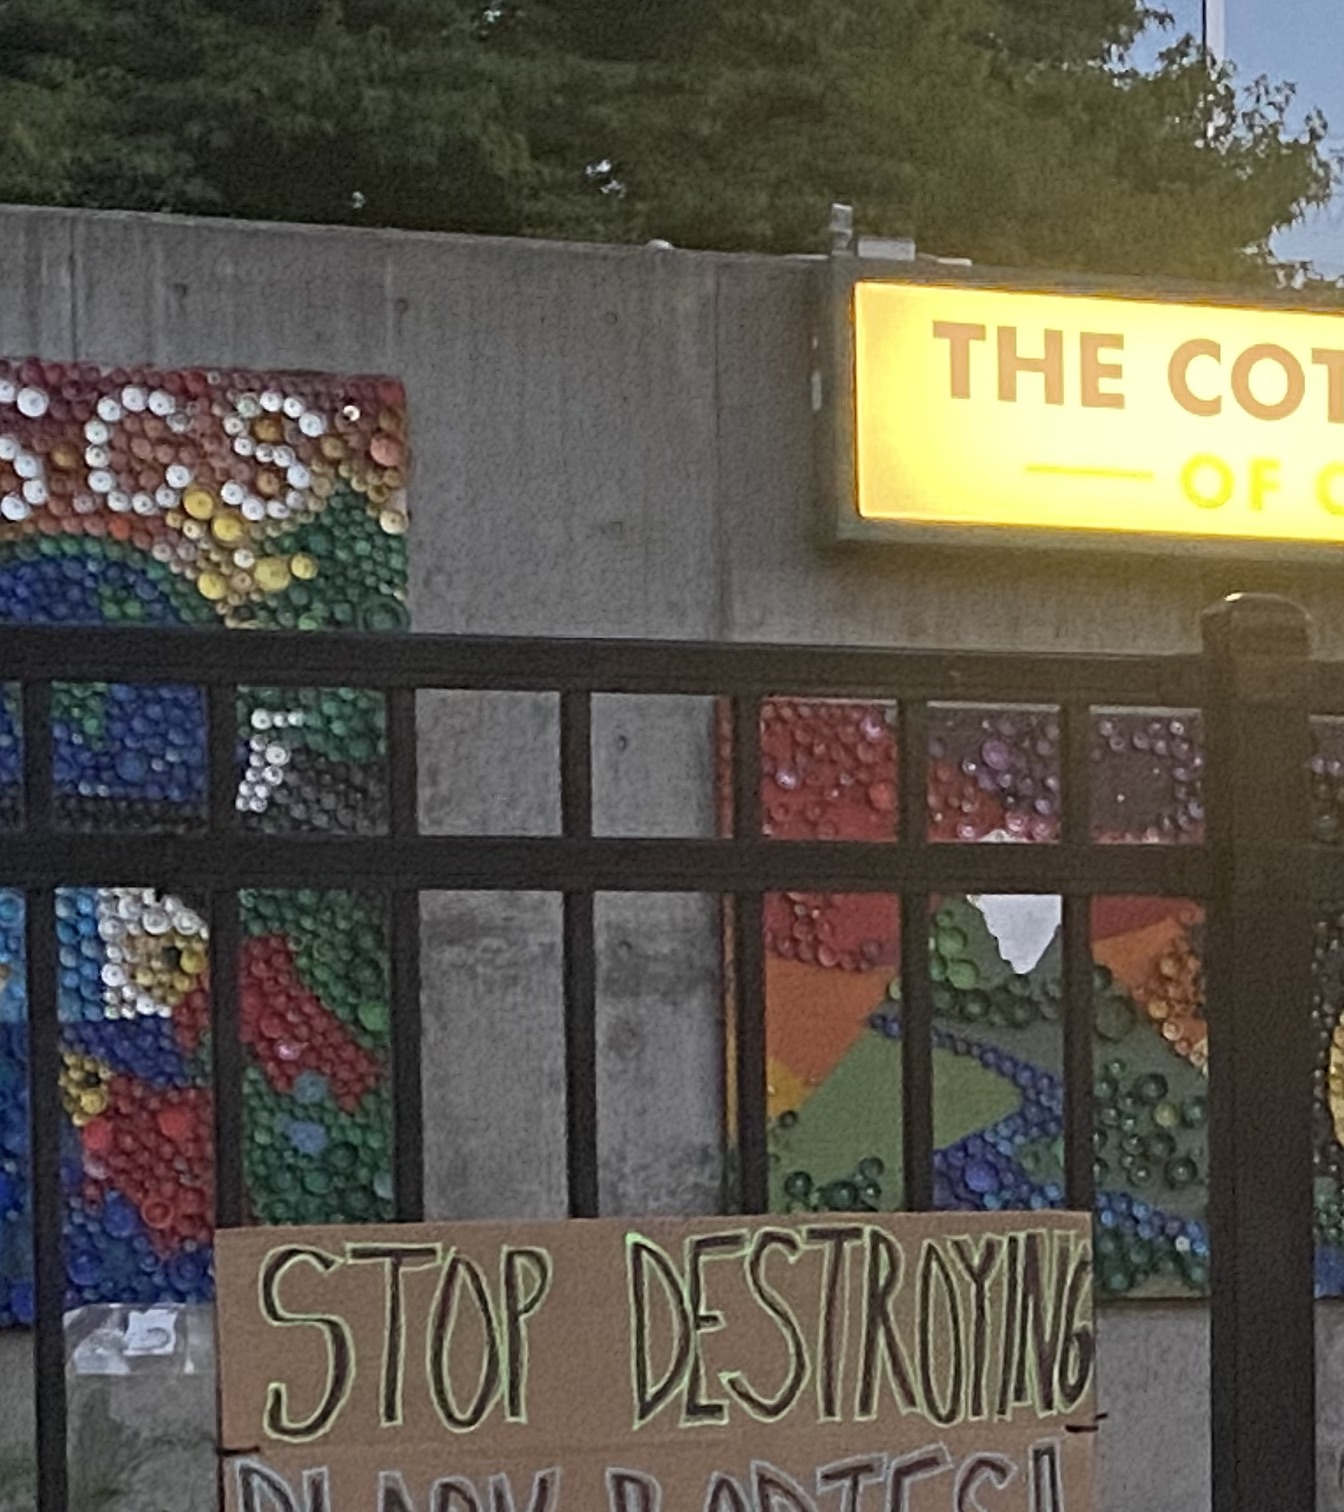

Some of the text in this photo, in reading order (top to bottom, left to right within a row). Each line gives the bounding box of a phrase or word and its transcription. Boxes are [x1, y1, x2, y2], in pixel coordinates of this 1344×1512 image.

[932, 320, 1125, 409] THE
[1180, 453, 1282, 512] OF
[258, 1225, 1093, 1440] STOP DESTROYING
